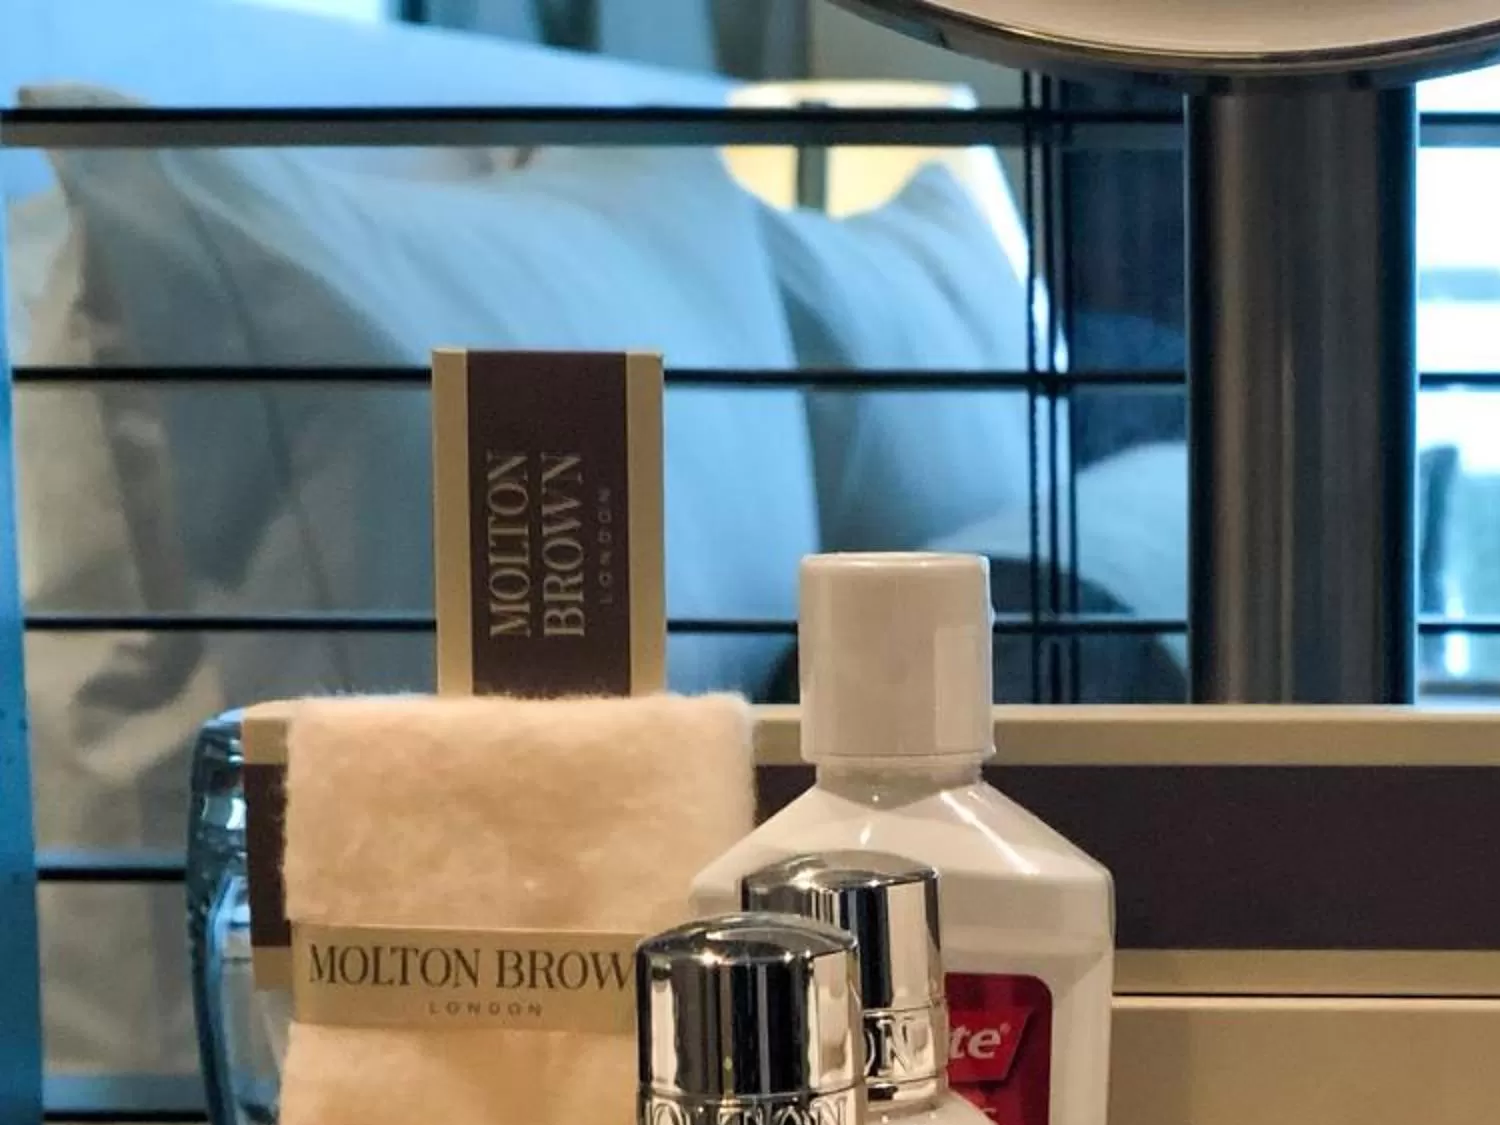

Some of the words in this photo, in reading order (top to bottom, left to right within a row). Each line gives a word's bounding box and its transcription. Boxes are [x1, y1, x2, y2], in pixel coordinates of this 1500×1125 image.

[486, 450, 531, 638] MOLTON
[540, 450, 585, 637] BROWN
[308, 943, 481, 989] MOLTON
[429, 1001, 543, 1017] LONDON
